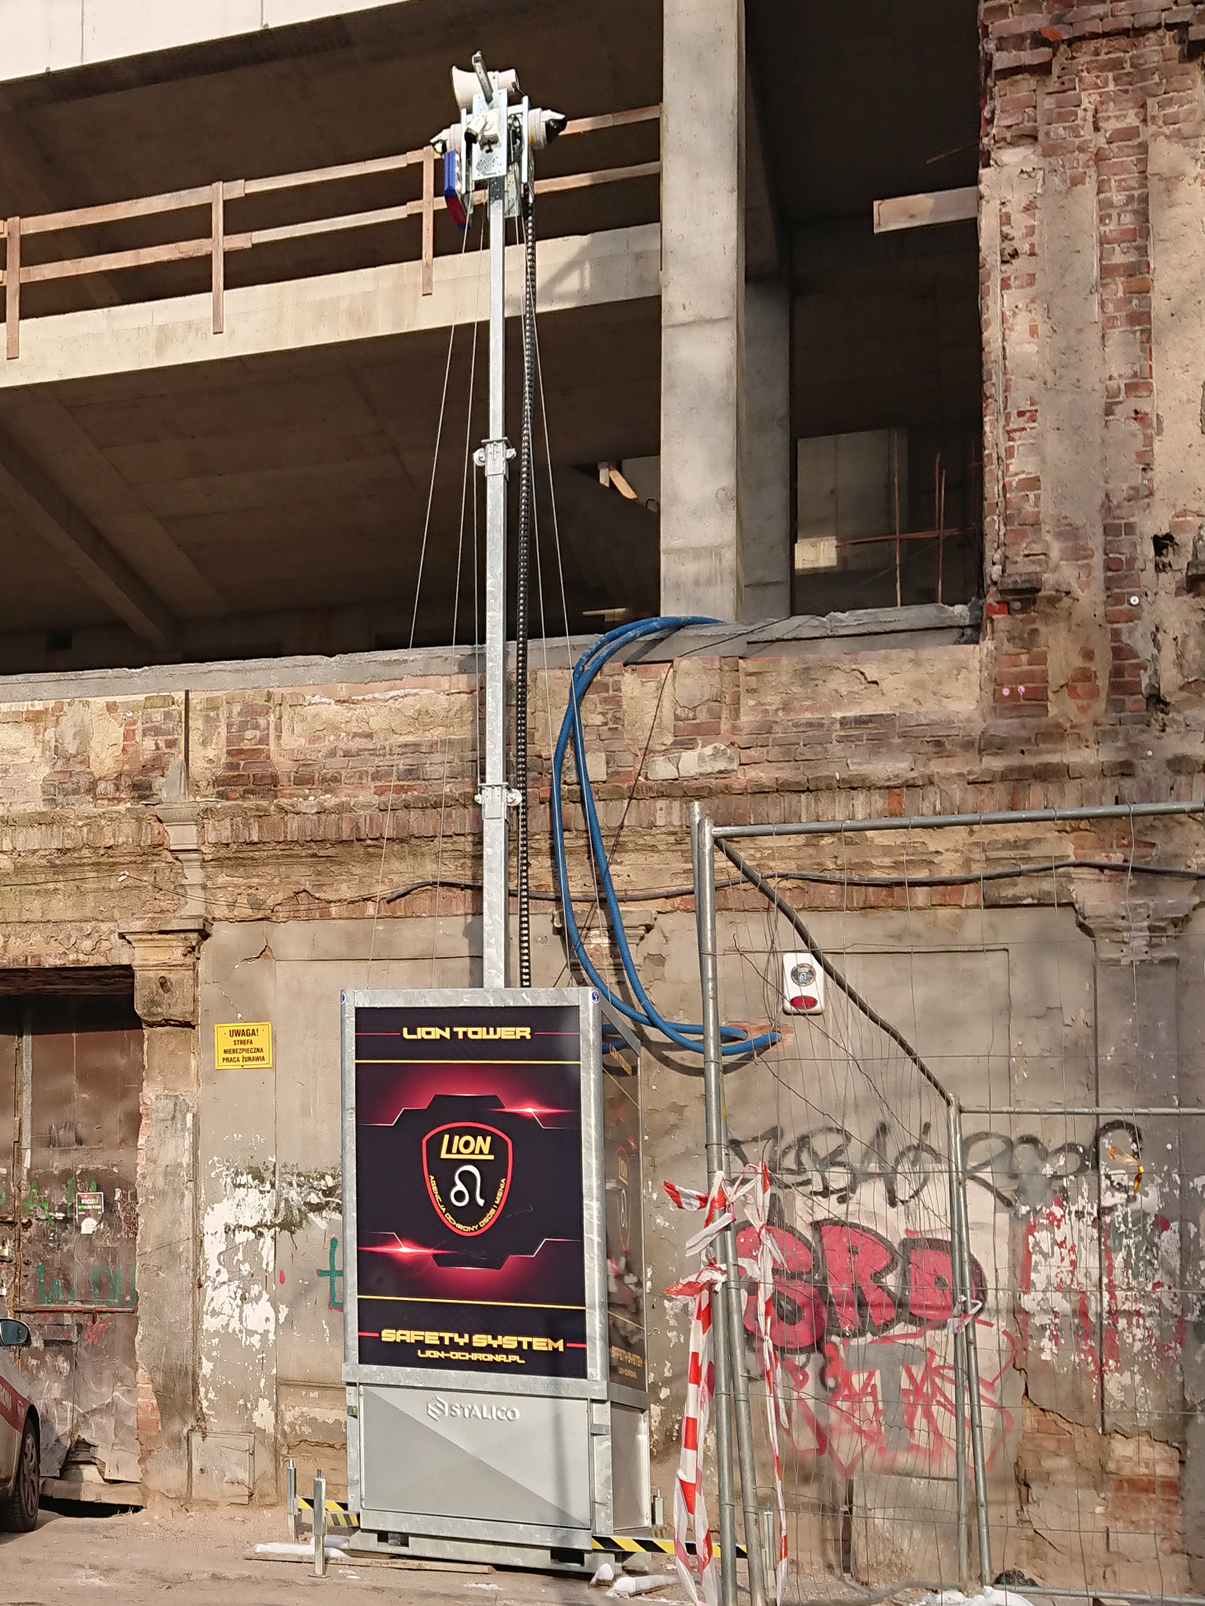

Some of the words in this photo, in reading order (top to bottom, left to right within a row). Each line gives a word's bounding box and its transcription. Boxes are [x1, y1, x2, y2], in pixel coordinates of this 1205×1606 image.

[229, 1028, 259, 1037] UWAGA!
[402, 1026, 450, 1040] LION
[452, 1026, 532, 1040] TOWER
[440, 1134, 495, 1160] LION
[429, 1174, 446, 1214] AGENCJA
[444, 1212, 479, 1232] OCHRONY
[381, 1328, 470, 1347] SAFETY
[471, 1333, 565, 1352] SYSTEM
[417, 1349, 526, 1364] LION-OCHRONA.PL
[449, 1404, 521, 1422] STALICO
